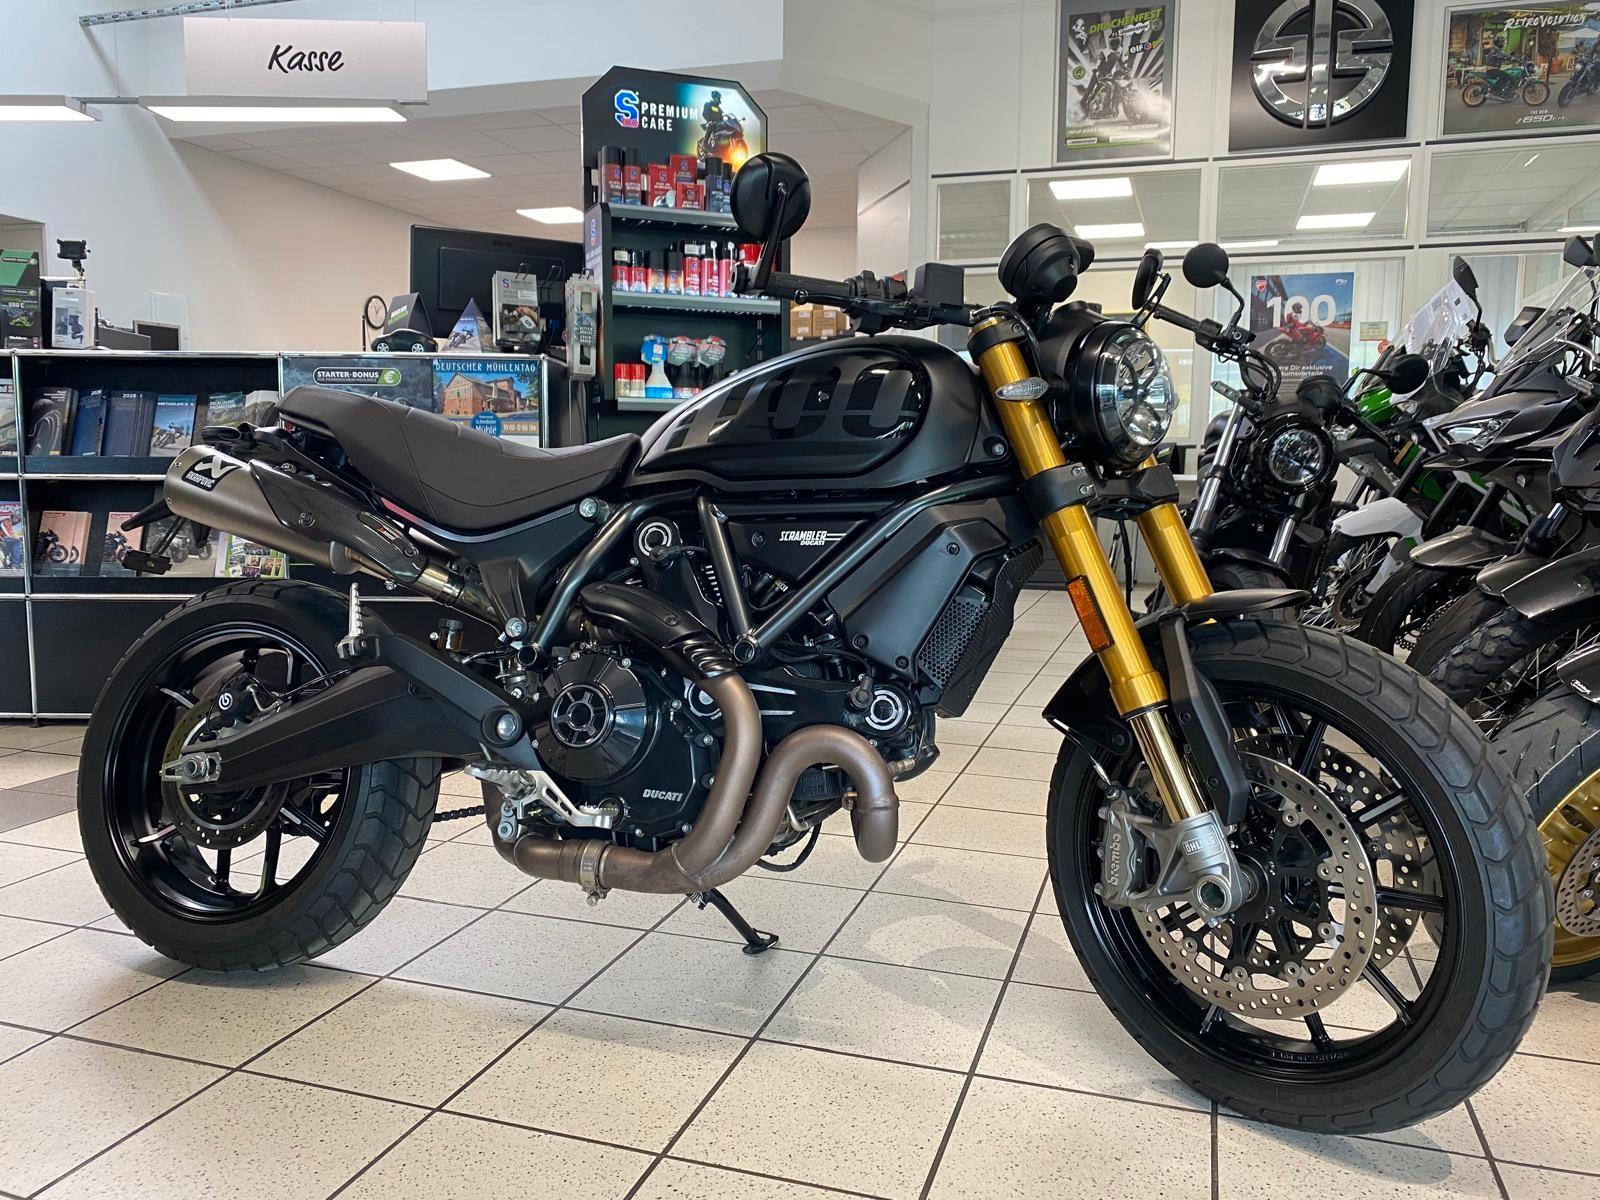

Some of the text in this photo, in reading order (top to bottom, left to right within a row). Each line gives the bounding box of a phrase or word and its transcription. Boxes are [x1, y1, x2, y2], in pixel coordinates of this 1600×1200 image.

[267, 44, 345, 74] Kasse
[641, 101, 699, 121] PREMIUM
[641, 116, 673, 132] CARE
[1266, 294, 1337, 328] 100
[434, 362, 537, 373] DEUTSCHER MÜHLENTAG
[779, 530, 828, 542] SCRAMBLER
[642, 788, 684, 802] DUCATI
[1107, 833, 1122, 886] brembo
